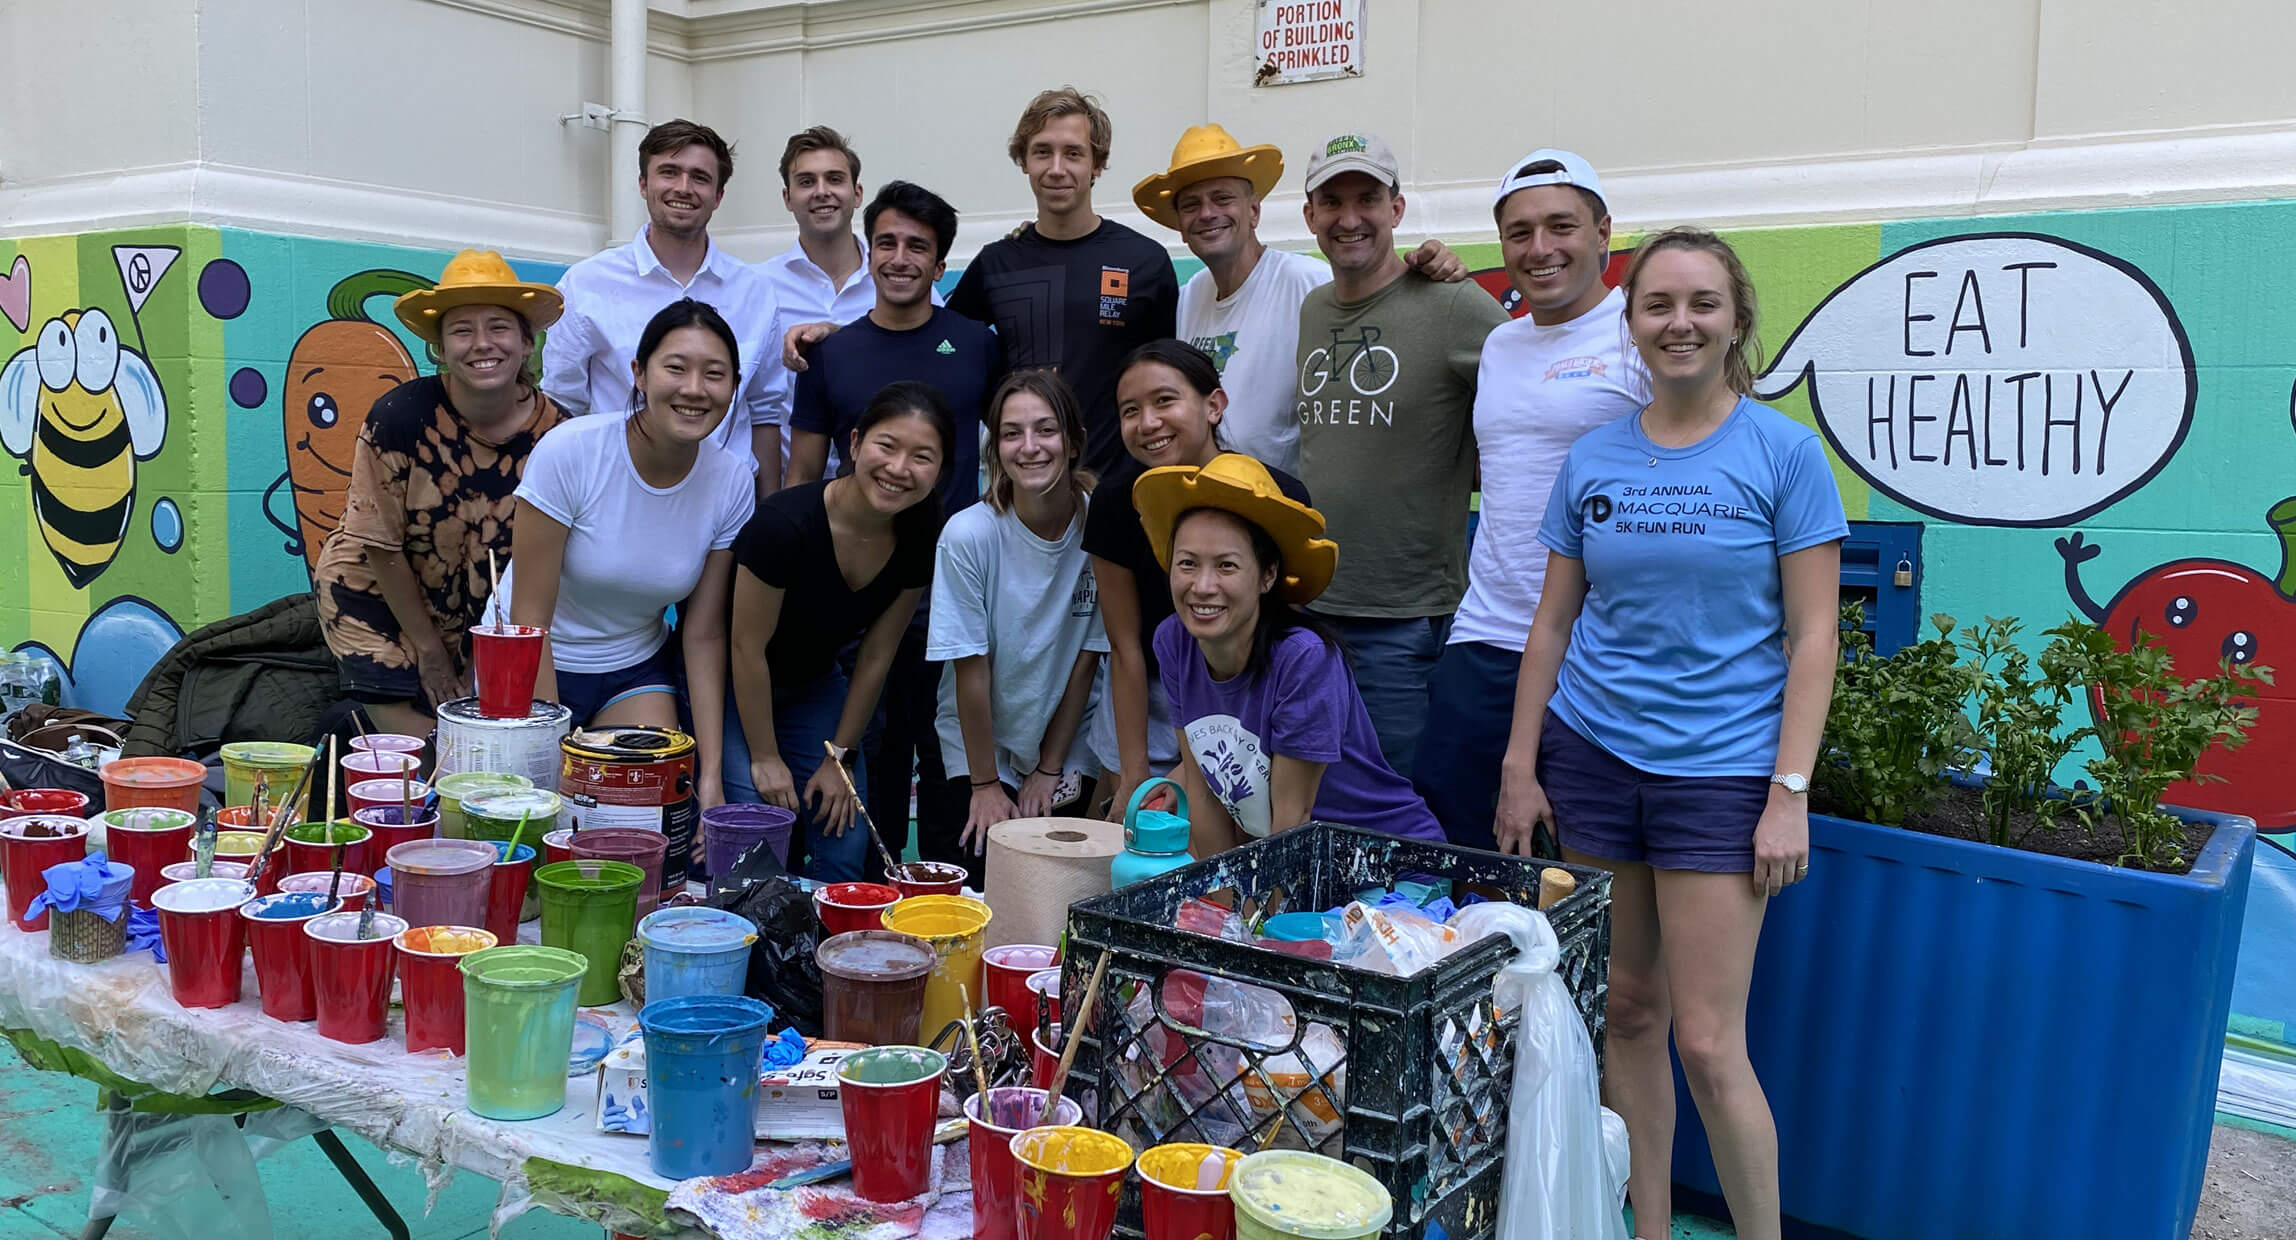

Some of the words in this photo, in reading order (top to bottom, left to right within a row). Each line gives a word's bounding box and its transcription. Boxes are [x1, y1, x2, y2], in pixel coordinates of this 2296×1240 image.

[1276, 0, 1341, 26] PORTION
[1263, 29, 1280, 49] OF
[1285, 21, 1354, 47] BUILDING
[1266, 44, 1350, 71] SPRINKLED
[1100, 310, 1120, 318] RELAY
[1904, 262, 2058, 357] EAT
[1301, 346, 1399, 396] GO
[1297, 399, 1394, 427] GREEN
[1868, 369, 2134, 476] HEALTHY
[1622, 486, 1646, 497] 3rd
[1650, 485, 1712, 496] ANNUAL
[1617, 501, 1750, 520] MACQUARIE
[1615, 522, 1632, 533] 5K
[1637, 521, 1666, 533] FUN
[1672, 521, 1706, 535] RUN
[819, 1090, 836, 1099] S/P
